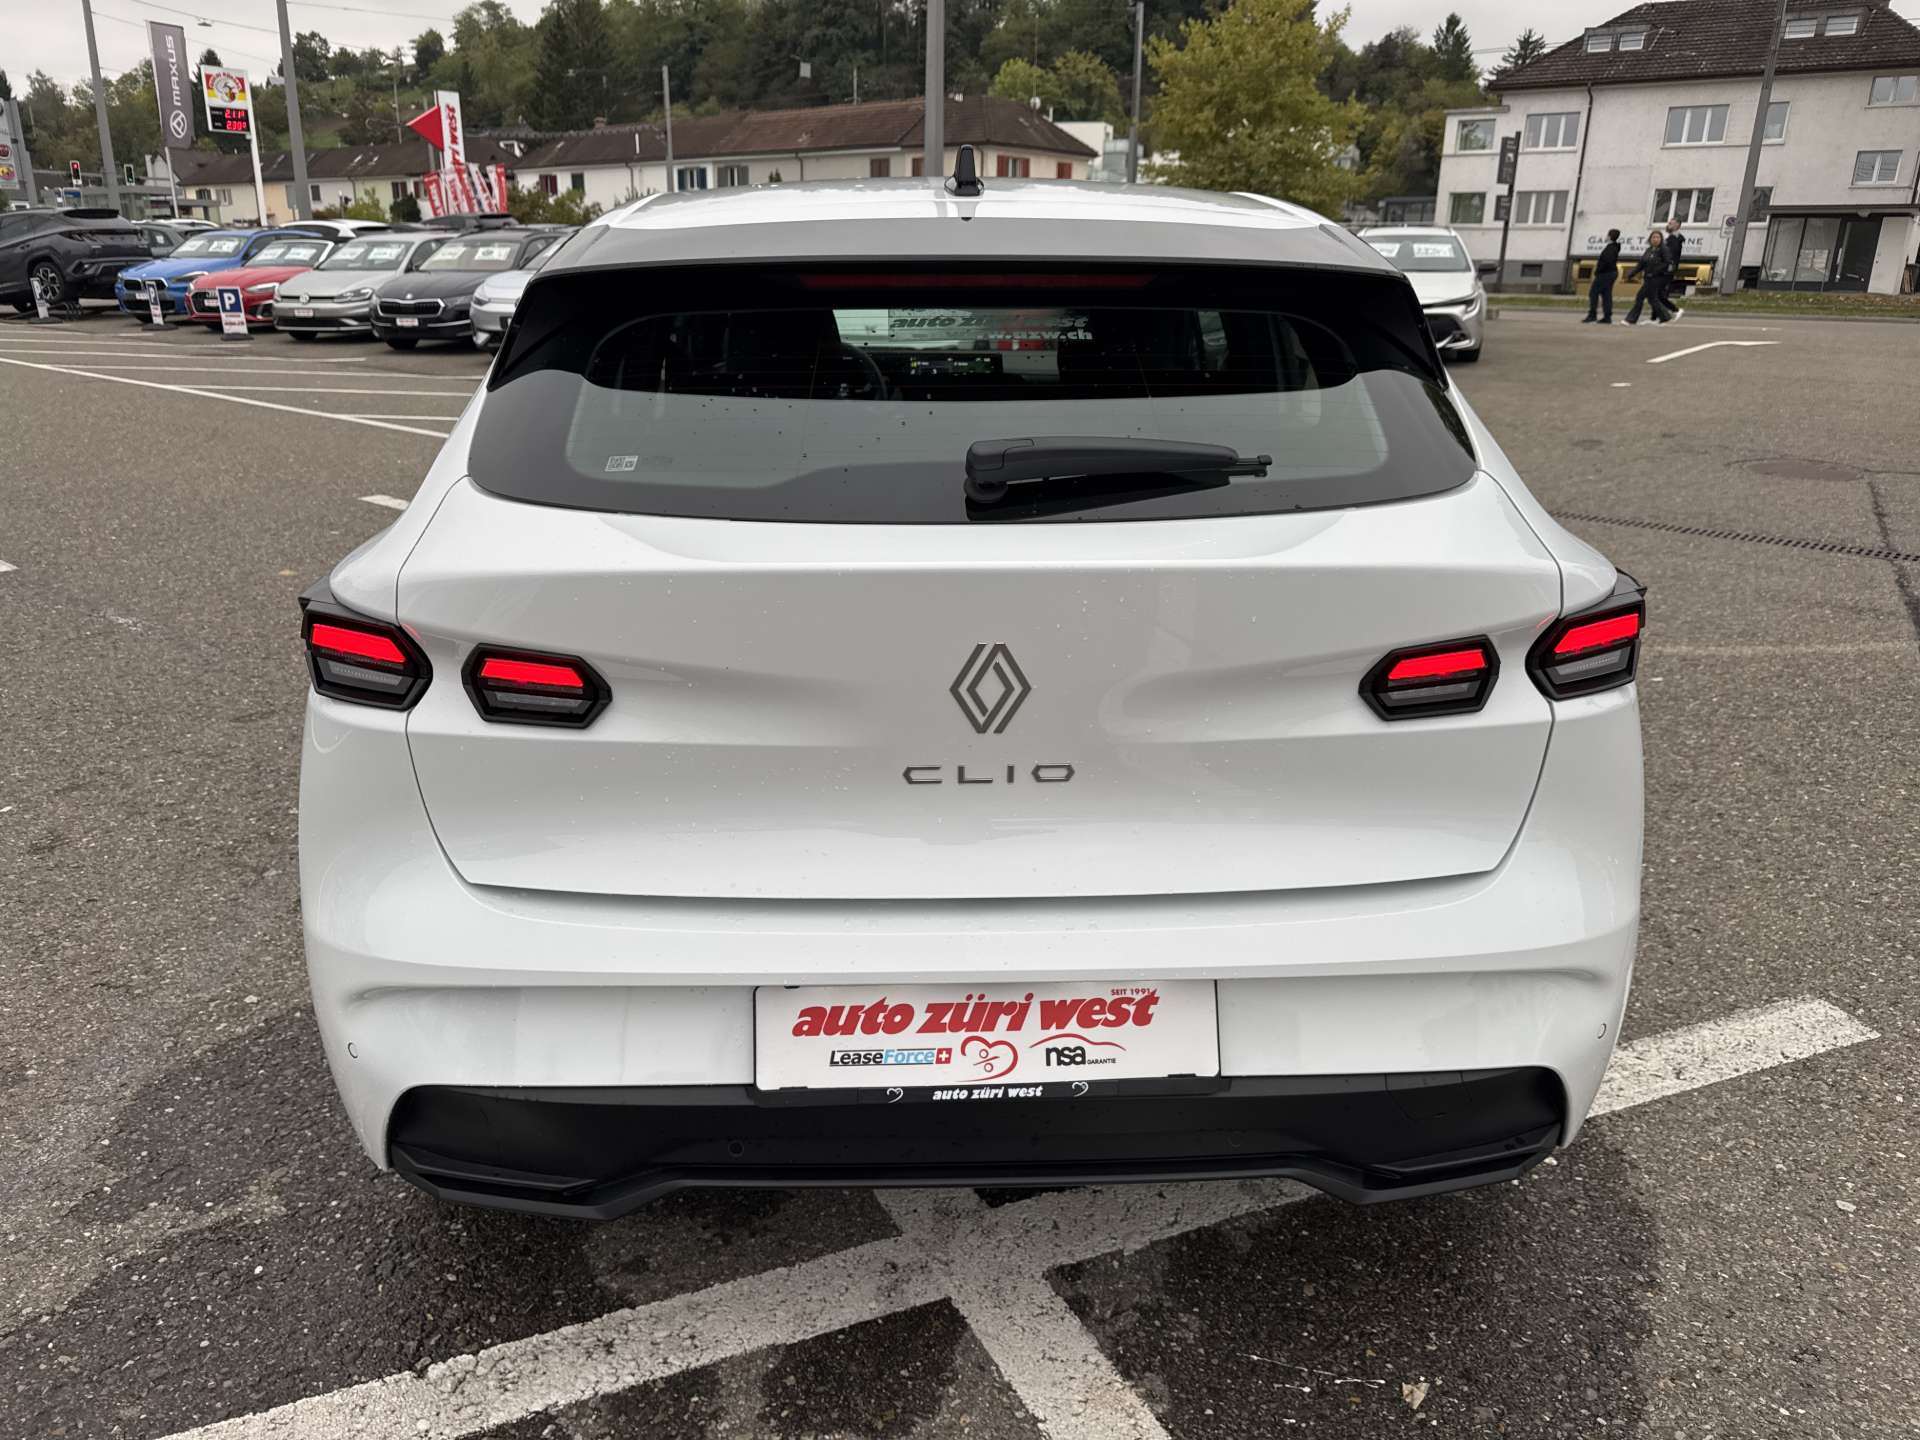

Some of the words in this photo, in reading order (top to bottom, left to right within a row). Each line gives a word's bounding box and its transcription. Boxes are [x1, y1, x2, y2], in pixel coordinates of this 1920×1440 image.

[166, 35, 182, 106] MAXUS
[223, 292, 236, 311] P
[889, 315, 956, 329] auto
[902, 763, 1075, 785] CLIO
[1111, 988, 1127, 996] SEIT
[1130, 987, 1151, 996] 1991
[792, 996, 915, 1037] auto
[916, 992, 1034, 1035] züri
[1040, 988, 1160, 1031] west
[829, 1049, 935, 1065] LeaseForce
[1045, 1045, 1086, 1067] nsa
[1086, 1057, 1117, 1065] GARANTIE
[933, 1088, 967, 1100] auto
[971, 1086, 1004, 1099] züri
[1008, 1085, 1043, 1098] west
